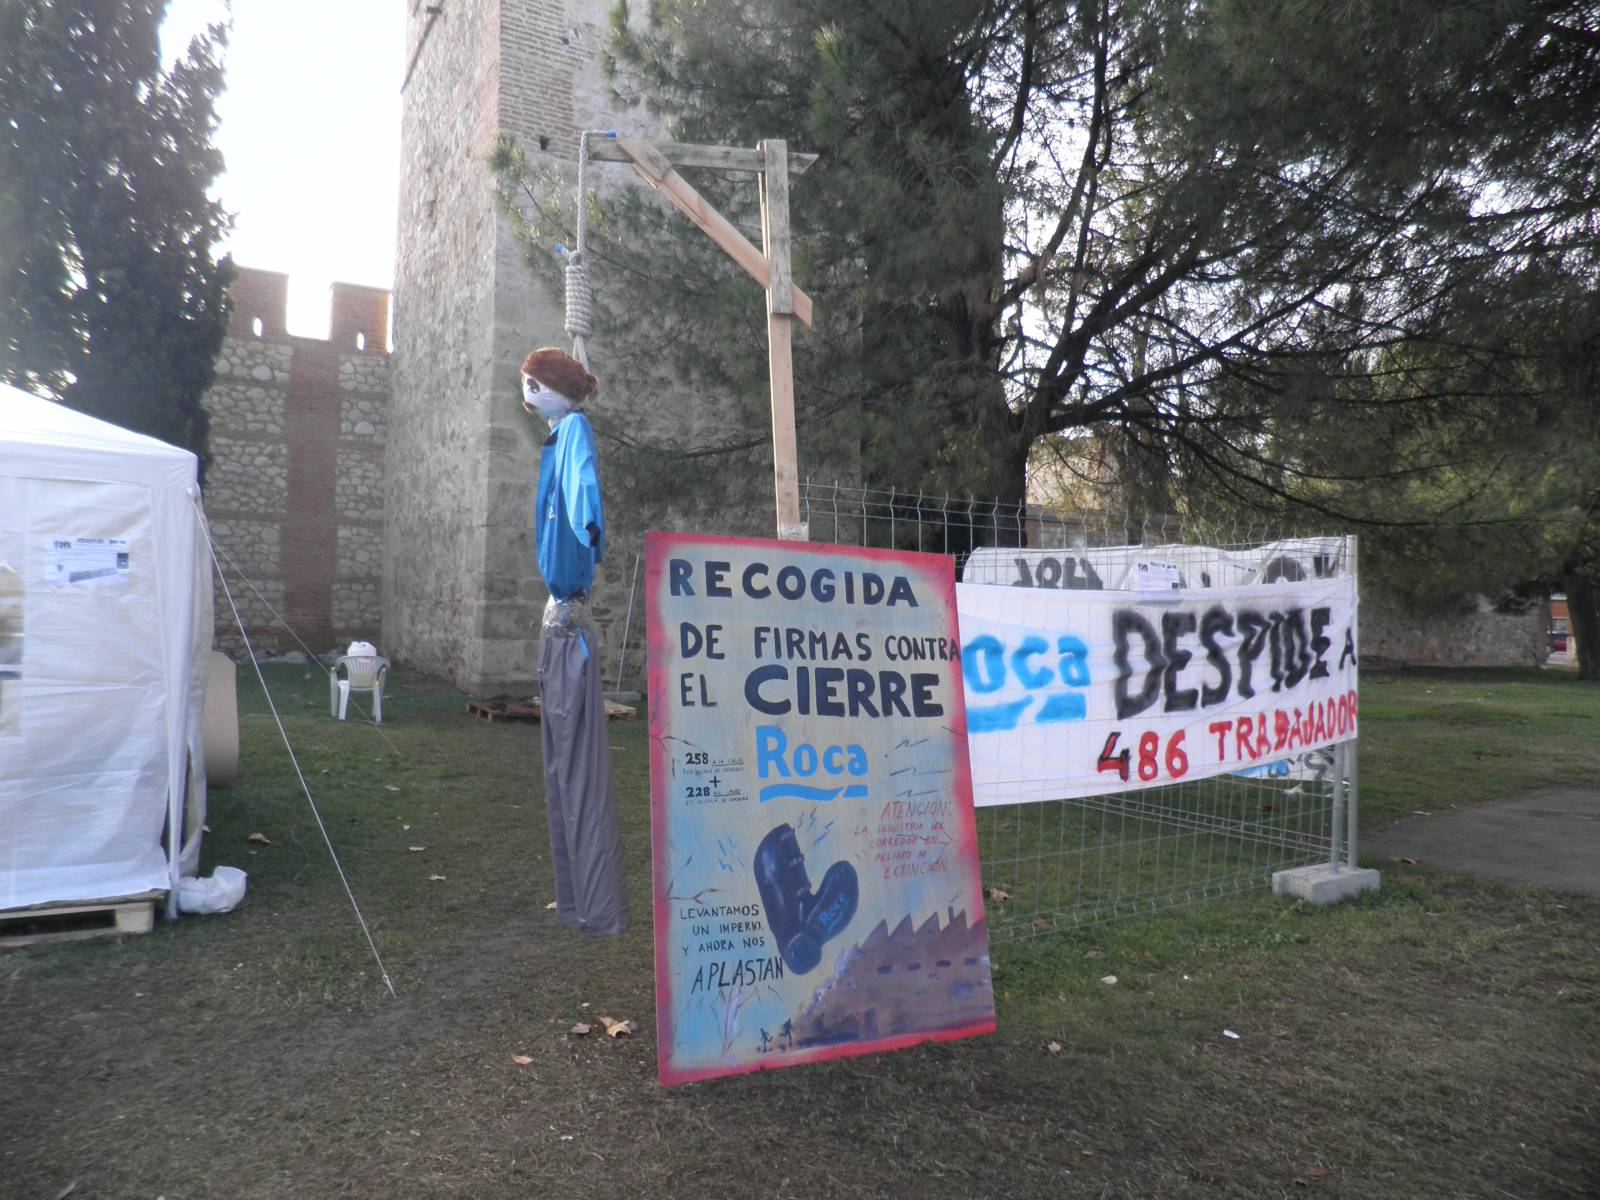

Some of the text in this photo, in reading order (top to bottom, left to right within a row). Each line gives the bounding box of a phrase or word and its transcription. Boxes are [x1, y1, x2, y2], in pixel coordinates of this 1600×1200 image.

[669, 559, 919, 607] RECOGIDA
[680, 622, 961, 661] DE FIRMAS CONTRA
[961, 606, 1356, 720] oca DESPIDE A
[681, 664, 944, 717] EL CIERRE
[685, 752, 709, 765] 258
[756, 725, 868, 778] Roca
[1097, 729, 1188, 782] 486
[685, 787, 710, 797] 228
[680, 904, 760, 920] LEVANTAMOS
[692, 925, 710, 936] UN
[682, 936, 765, 957] Y AHORA NOS
[691, 956, 783, 994] APLASTAN
